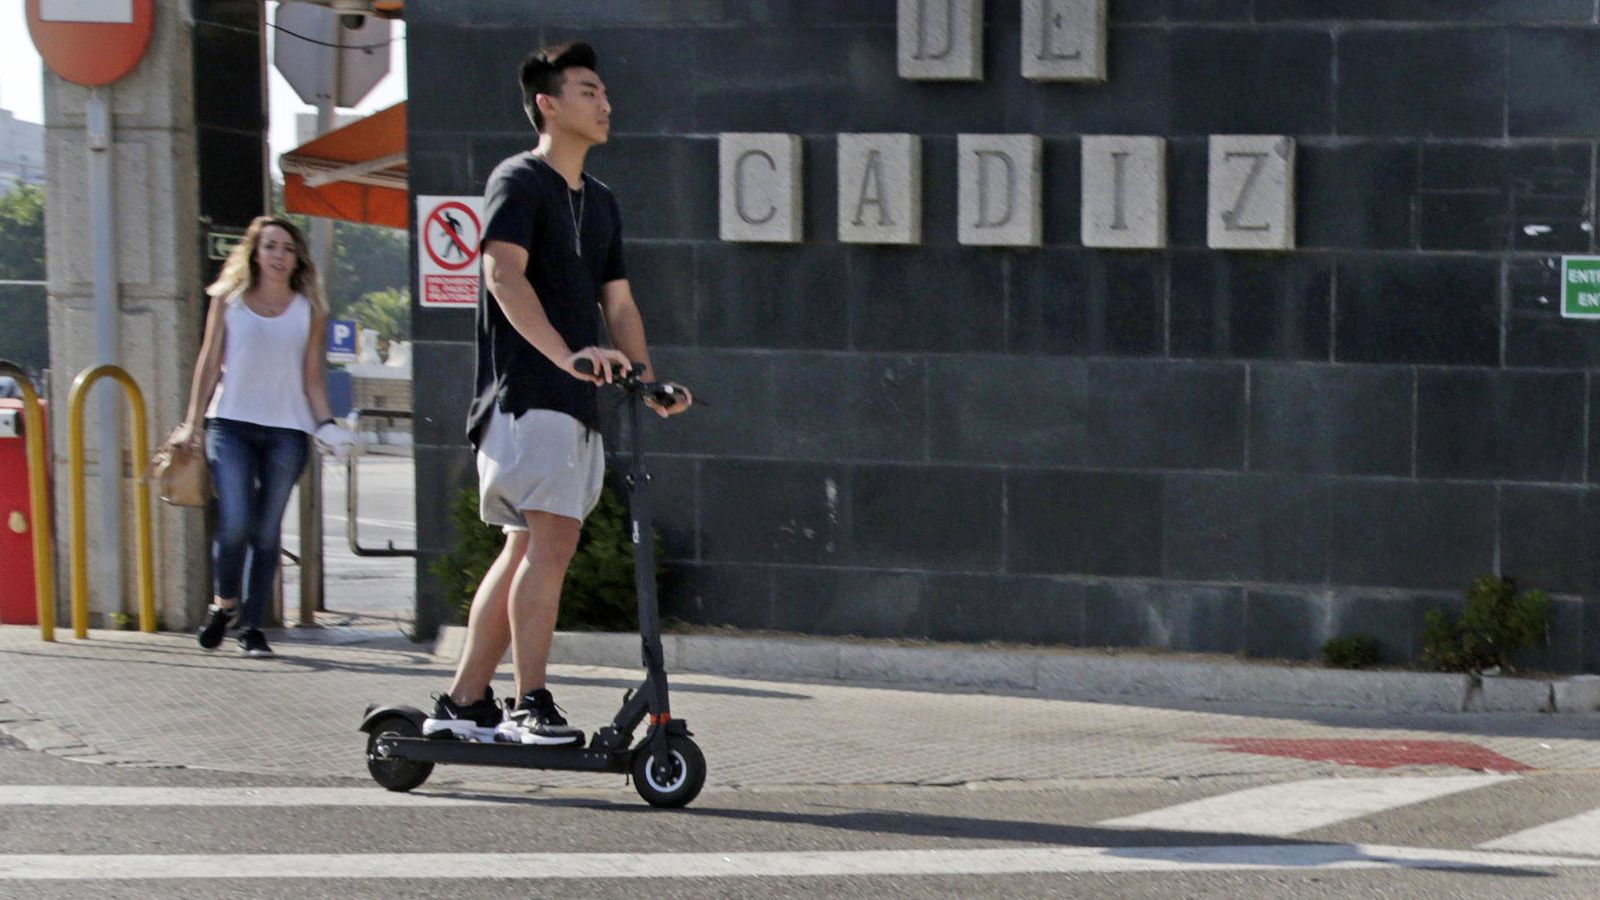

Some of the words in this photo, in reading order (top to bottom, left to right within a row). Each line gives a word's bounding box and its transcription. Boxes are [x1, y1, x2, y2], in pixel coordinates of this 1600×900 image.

[911, 0, 1081, 61] DE
[732, 148, 1273, 233] CADIZ
[1578, 292, 1600, 307] EN
[333, 323, 351, 346] P
